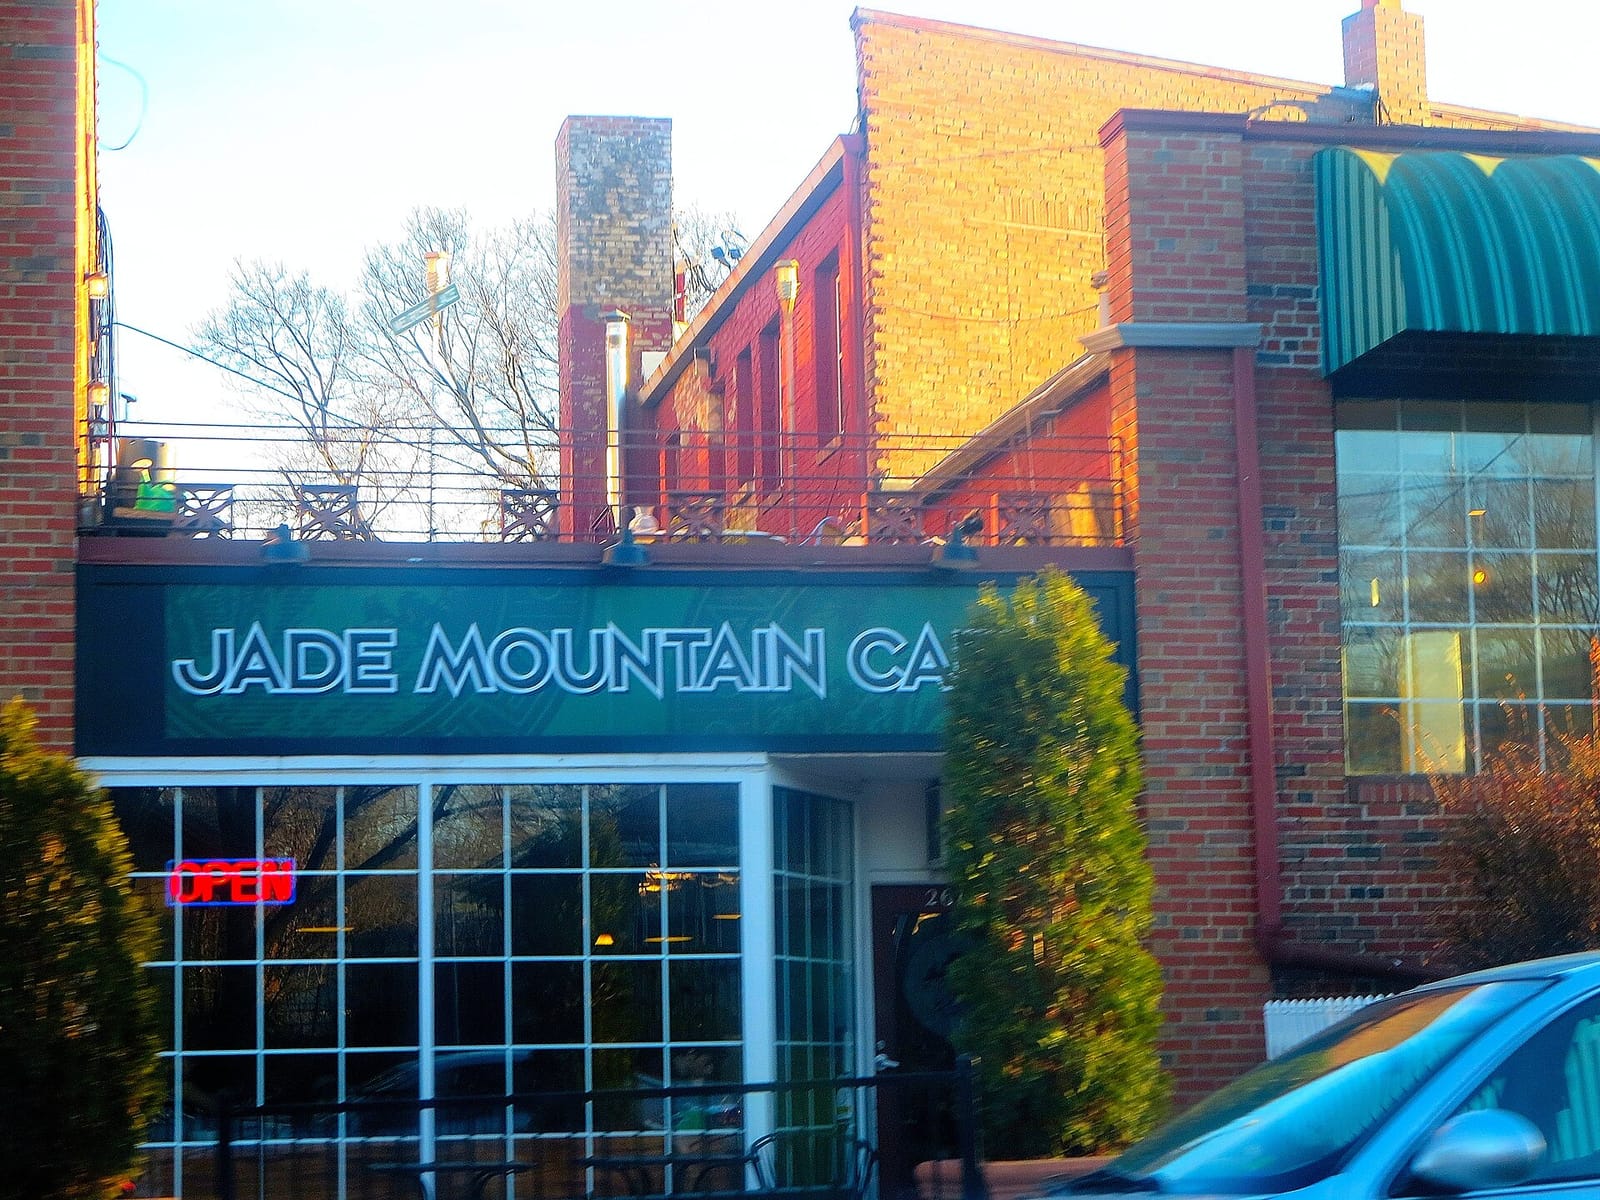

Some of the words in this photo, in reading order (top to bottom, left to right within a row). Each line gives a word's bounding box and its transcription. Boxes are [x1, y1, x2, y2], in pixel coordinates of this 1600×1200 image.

[171, 620, 398, 696] JADE
[412, 620, 827, 700] MOUNTAIN
[846, 620, 960, 693] CA
[169, 860, 293, 903] OPEN
